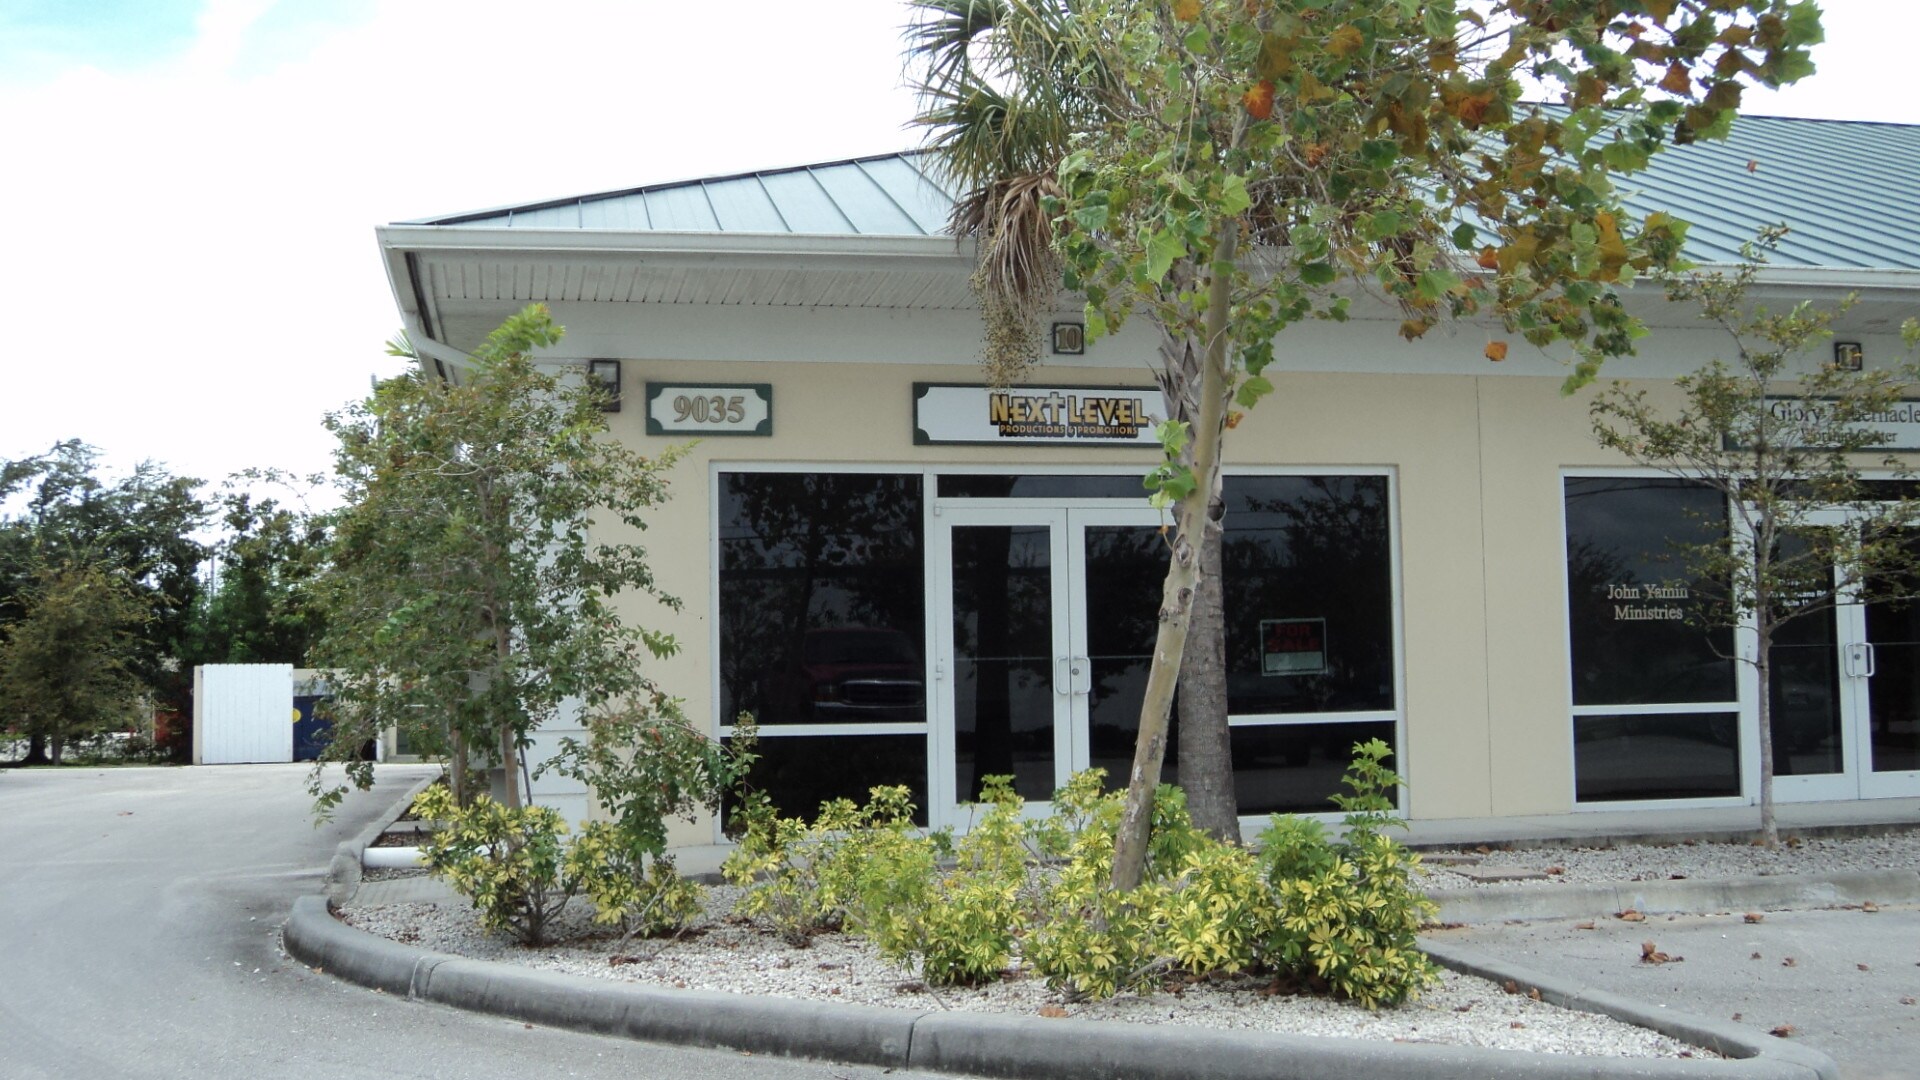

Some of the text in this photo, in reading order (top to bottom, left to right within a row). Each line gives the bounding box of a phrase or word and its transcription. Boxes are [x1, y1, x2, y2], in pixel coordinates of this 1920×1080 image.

[1056, 327, 1082, 350] 10
[673, 395, 745, 423] 9035
[990, 392, 1148, 426] NEXT LEVEL
[1000, 424, 1065, 436] PRODUCTIONS
[1077, 426, 1138, 437] PROMOTIONS
[1607, 583, 1689, 599] John Yamin
[1614, 604, 1684, 620] Ministries
